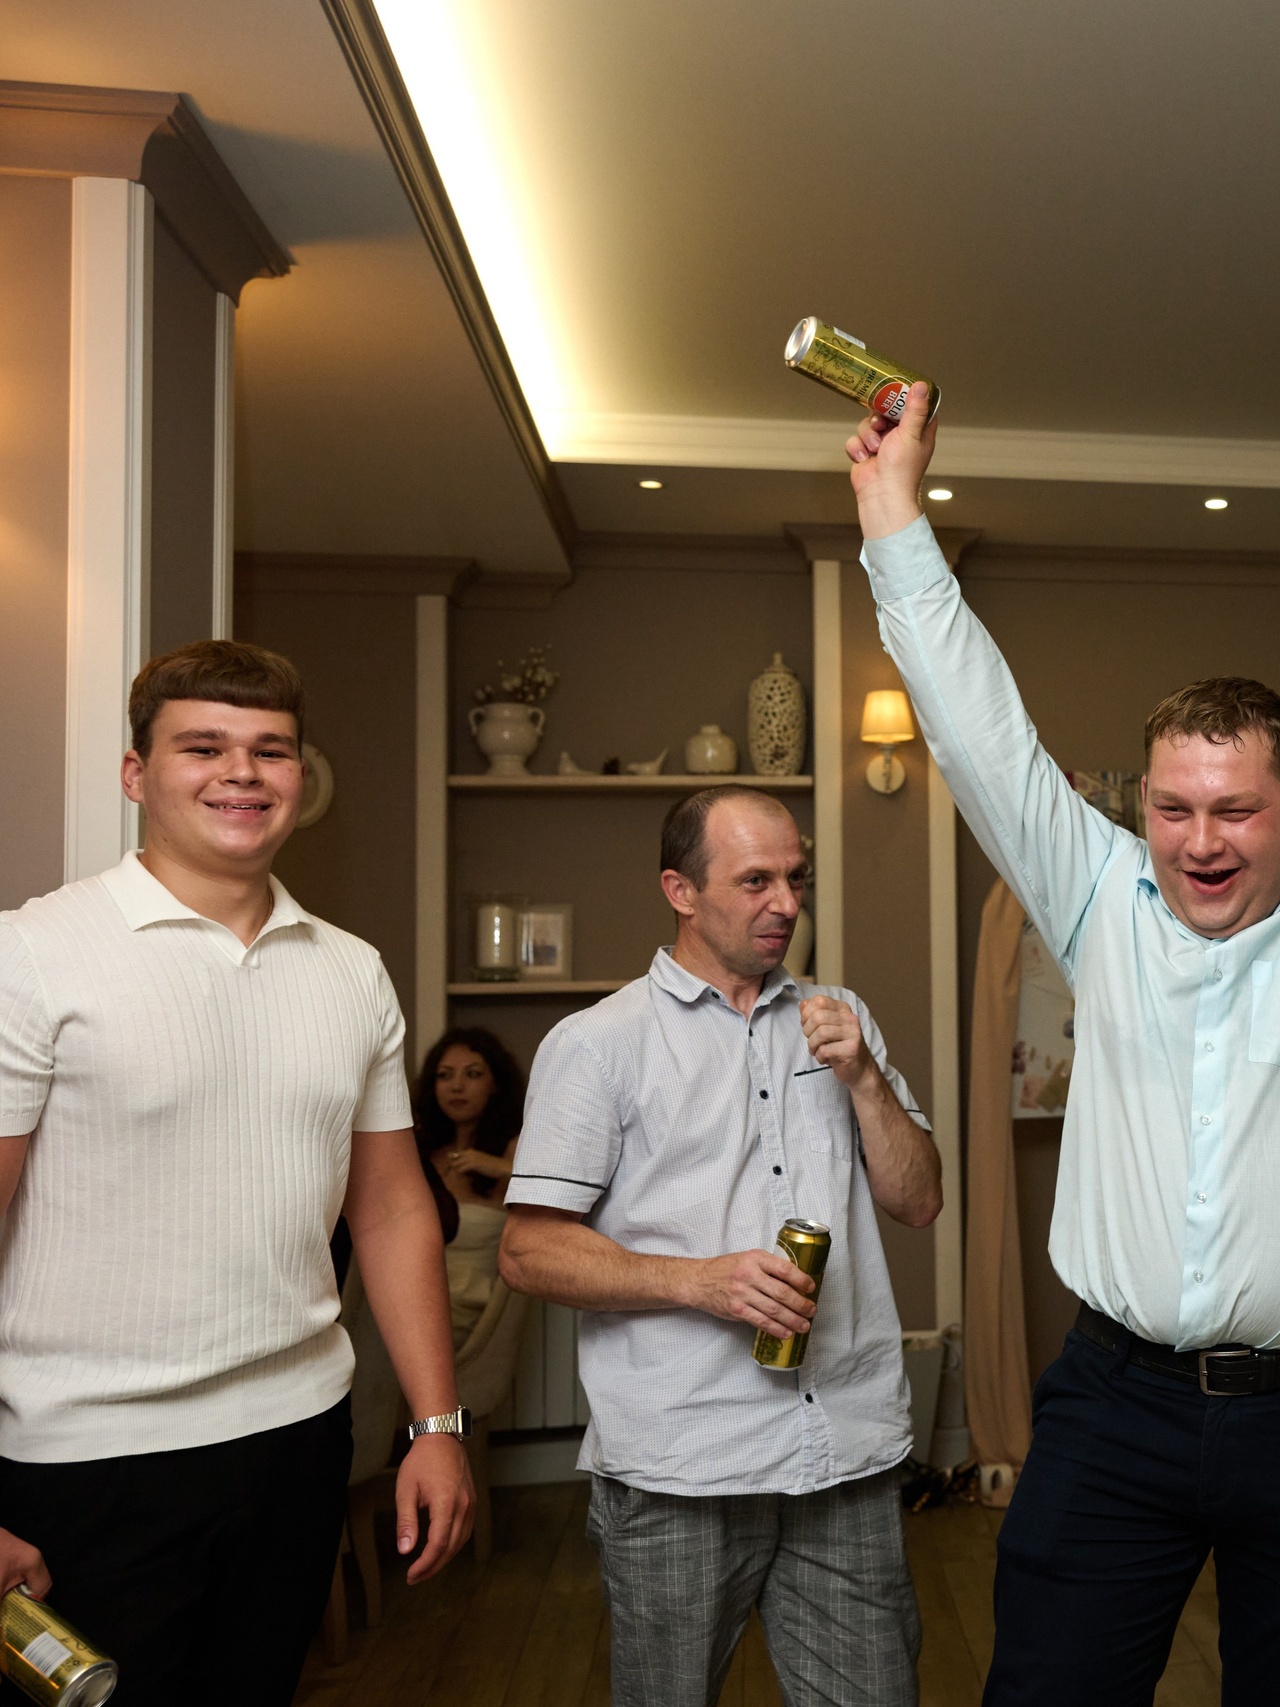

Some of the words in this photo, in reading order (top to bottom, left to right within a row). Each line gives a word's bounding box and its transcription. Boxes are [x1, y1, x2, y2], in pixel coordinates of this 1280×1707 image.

[857, 369, 876, 398] PREMIU
[881, 390, 897, 409] BIER
[888, 391, 907, 417] GOLD
